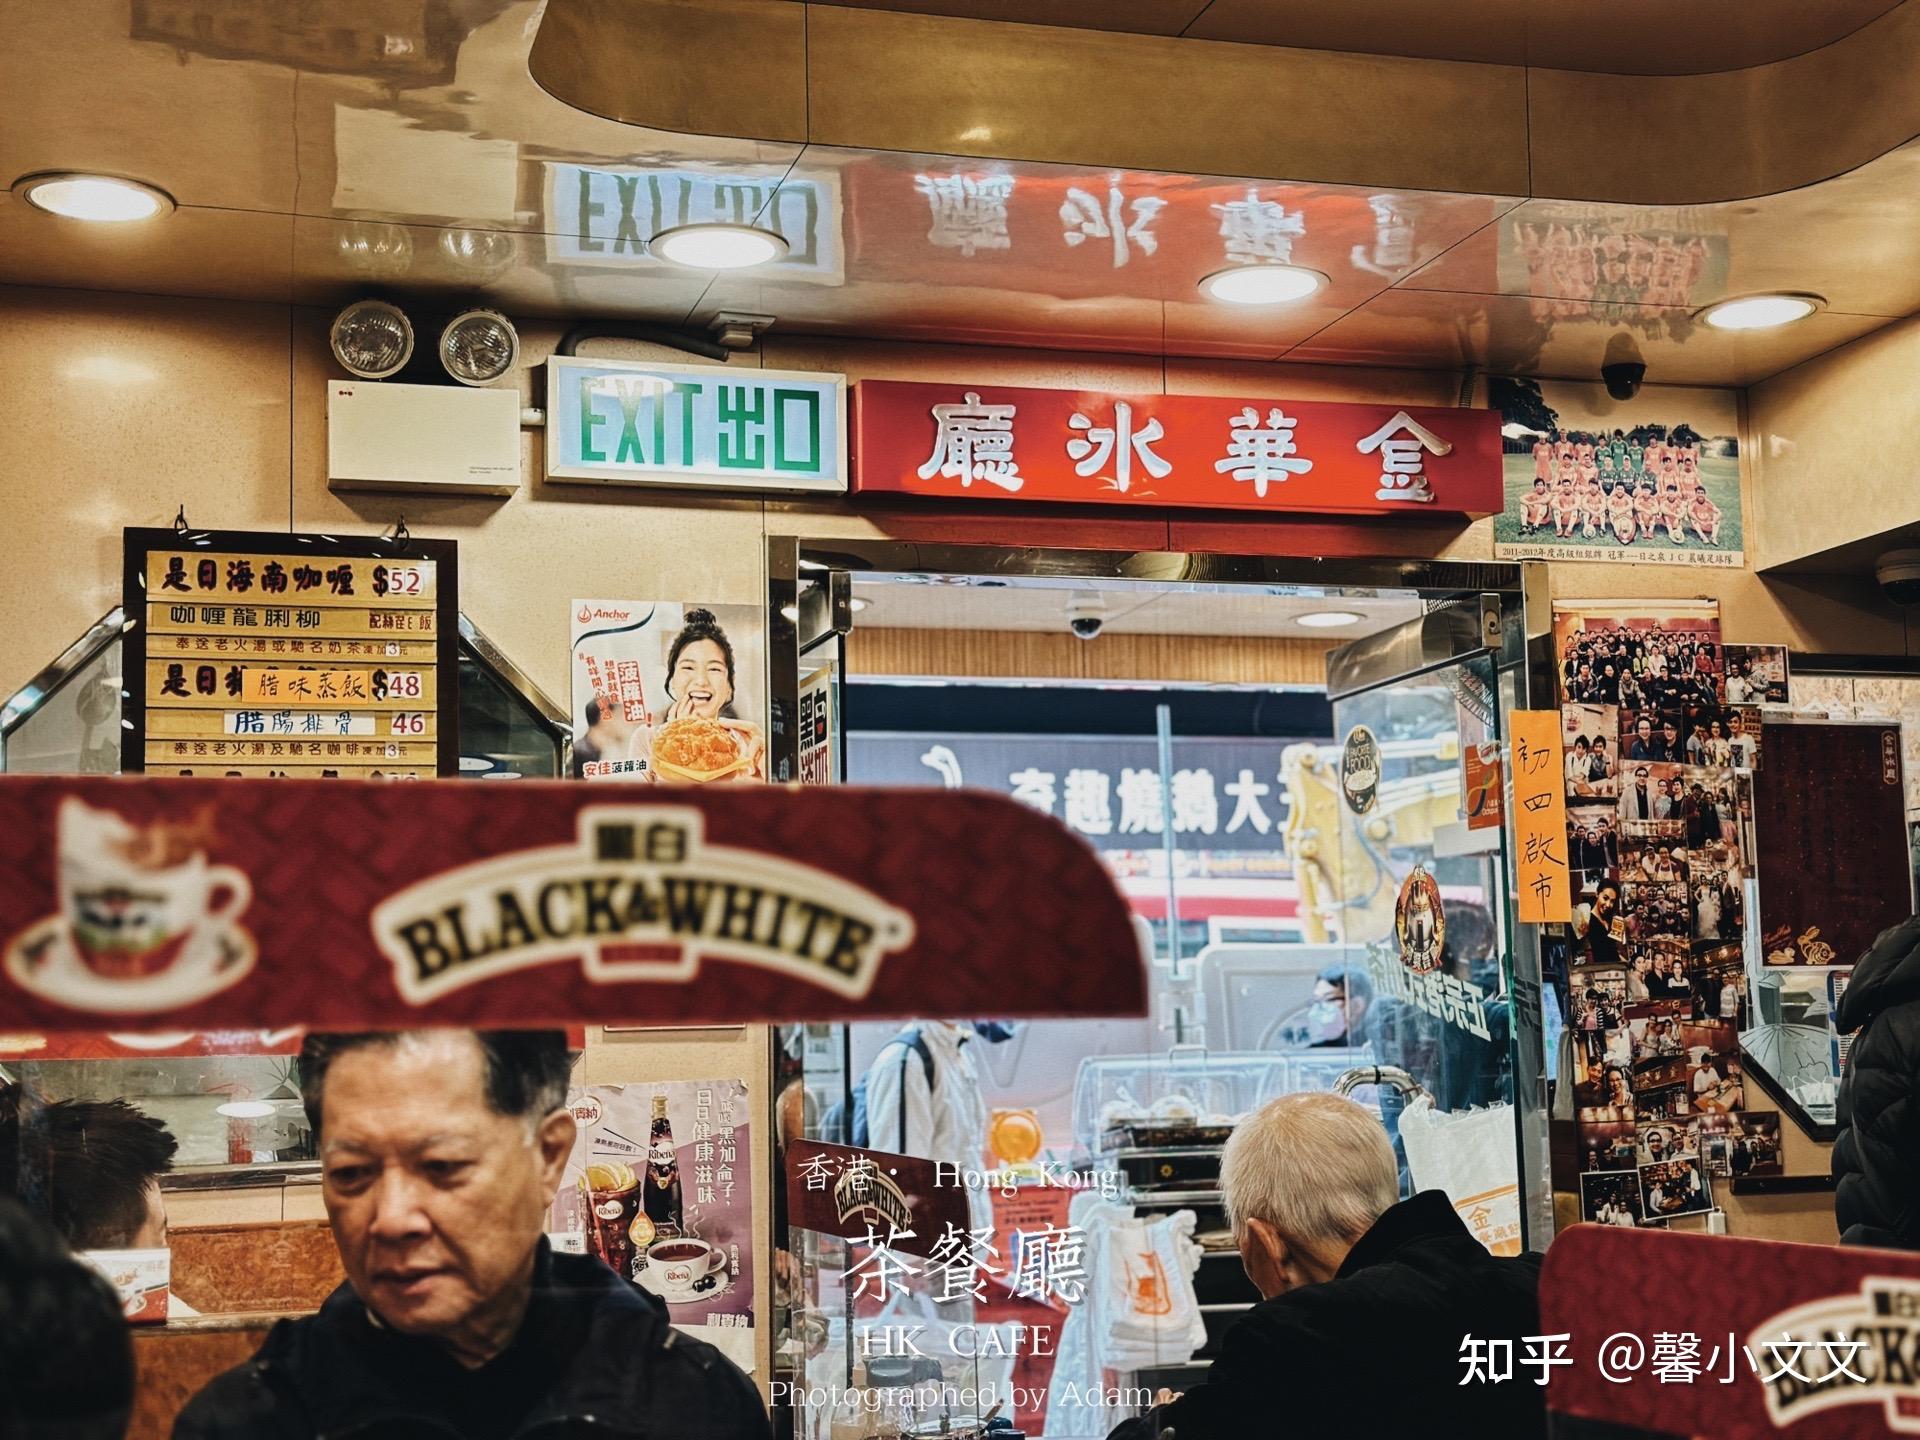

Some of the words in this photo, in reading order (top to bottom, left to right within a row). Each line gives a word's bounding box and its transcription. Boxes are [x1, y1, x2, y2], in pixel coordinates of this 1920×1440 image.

[579, 375, 703, 466] EXIT
[718, 384, 820, 473] 出口
[372, 564, 421, 597] $52
[593, 608, 630, 619] Anchor
[372, 669, 420, 700] $48
[392, 713, 424, 734] 46
[584, 759, 647, 778] 安佳菠蘿油
[570, 1106, 598, 1119] 賓納
[649, 1149, 675, 1161] Ribena
[693, 1089, 716, 1204] 日日健康滋味
[598, 1205, 621, 1216] Ribena
[667, 1270, 690, 1281] Ribena
